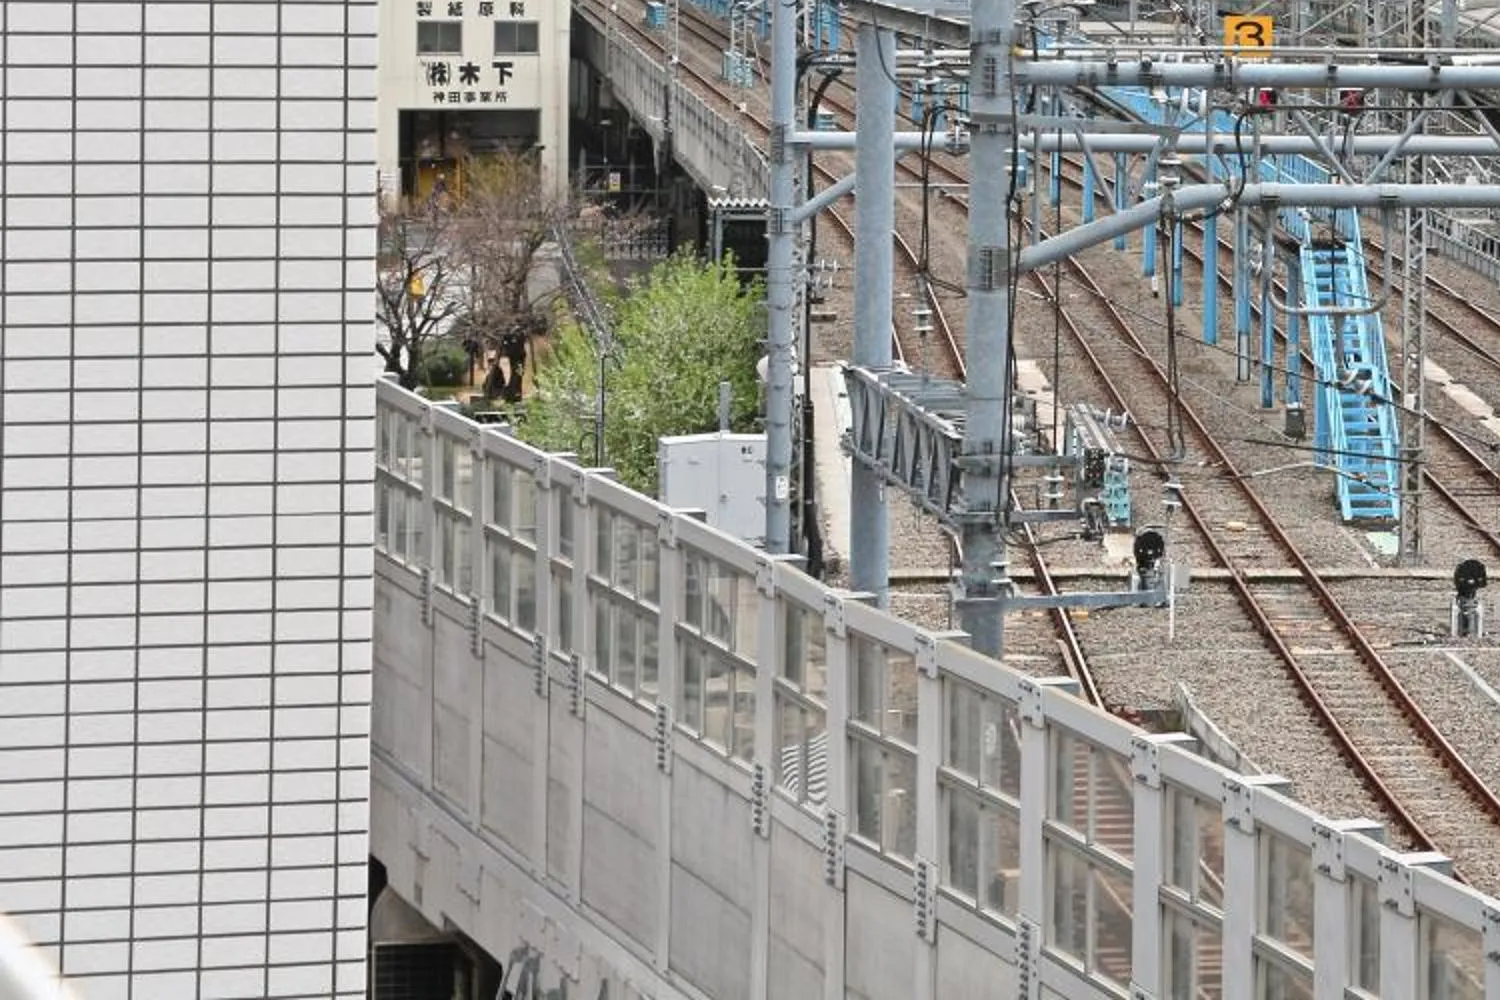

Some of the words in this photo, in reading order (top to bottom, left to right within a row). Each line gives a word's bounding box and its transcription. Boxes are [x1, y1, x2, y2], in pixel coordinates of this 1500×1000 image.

[416, 1, 525, 17] 製紙原料
[1235, 21, 1265, 54] 3
[433, 91, 507, 104] 神田事業所
